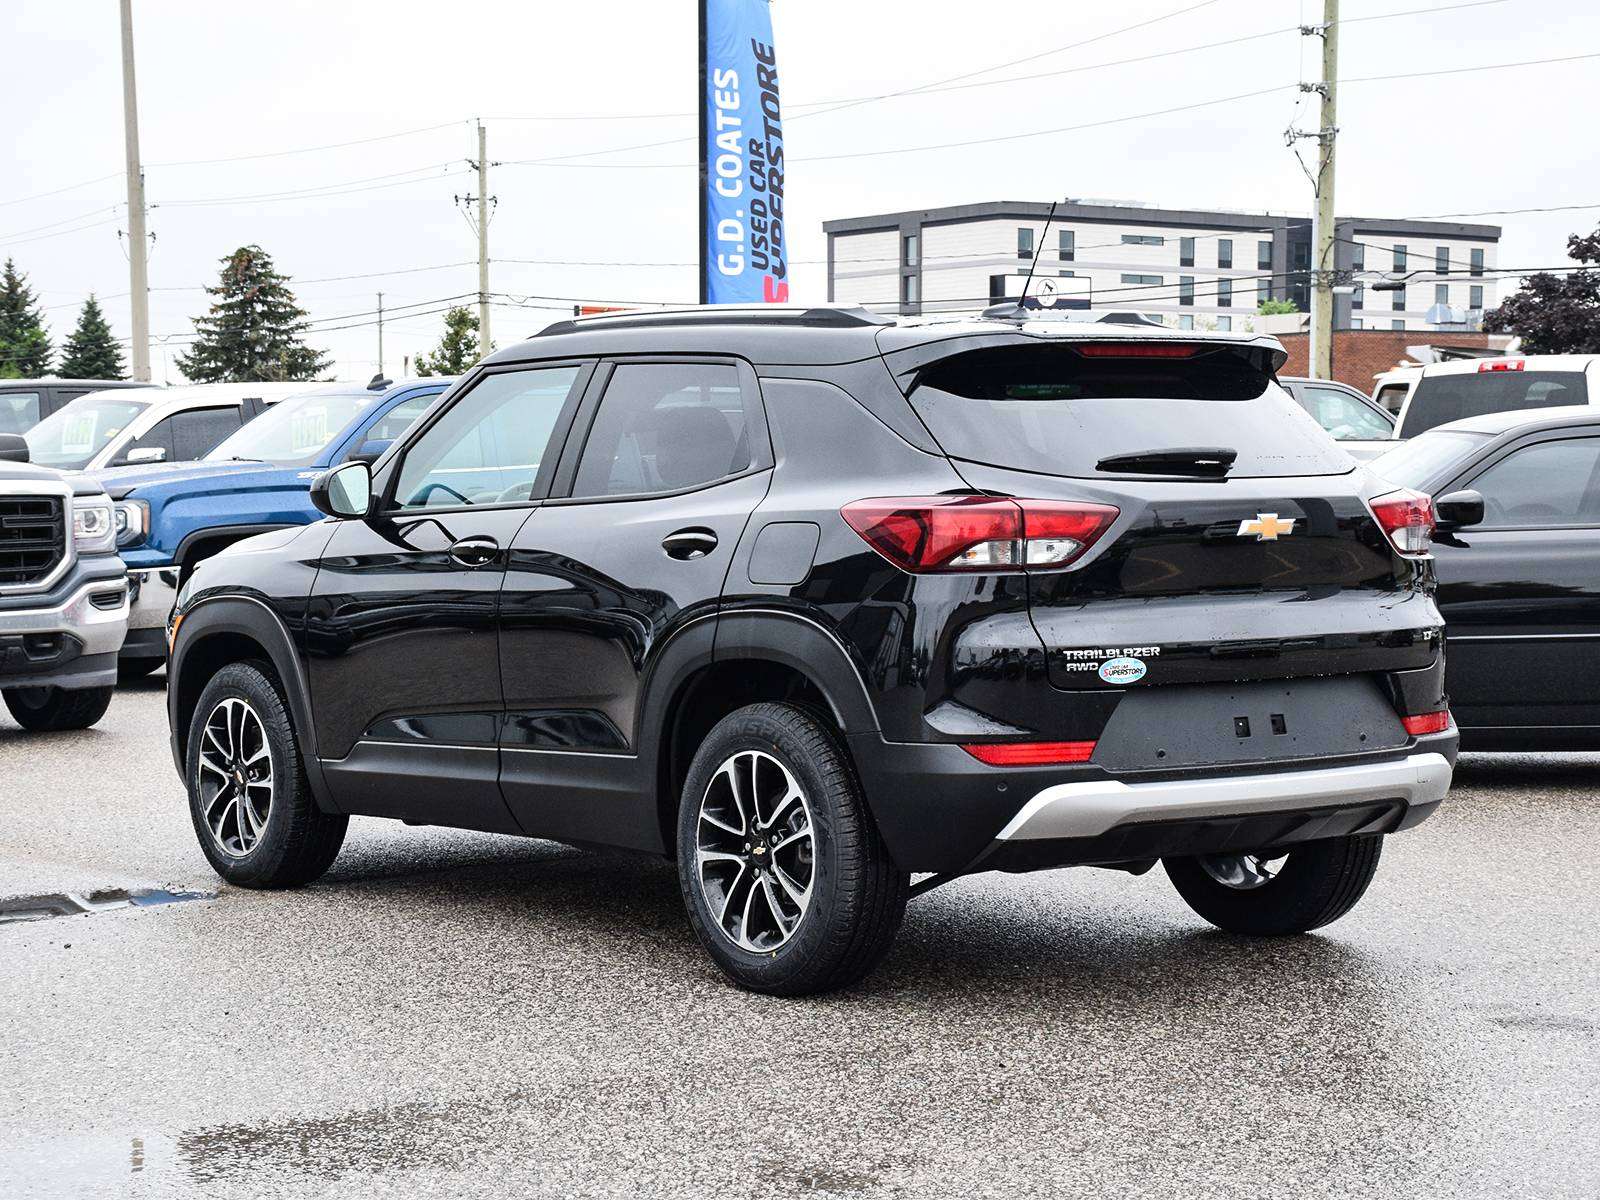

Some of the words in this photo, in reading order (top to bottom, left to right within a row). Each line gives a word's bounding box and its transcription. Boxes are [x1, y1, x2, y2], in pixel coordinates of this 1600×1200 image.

[714, 67, 743, 198] COATES
[749, 137, 767, 193] CAR
[750, 37, 789, 303] SUPERSTORE
[717, 210, 744, 276] G.D.
[750, 199, 769, 271] USED
[1063, 647, 1160, 660] TRAILBLAZER
[1066, 662, 1099, 672] AWD
